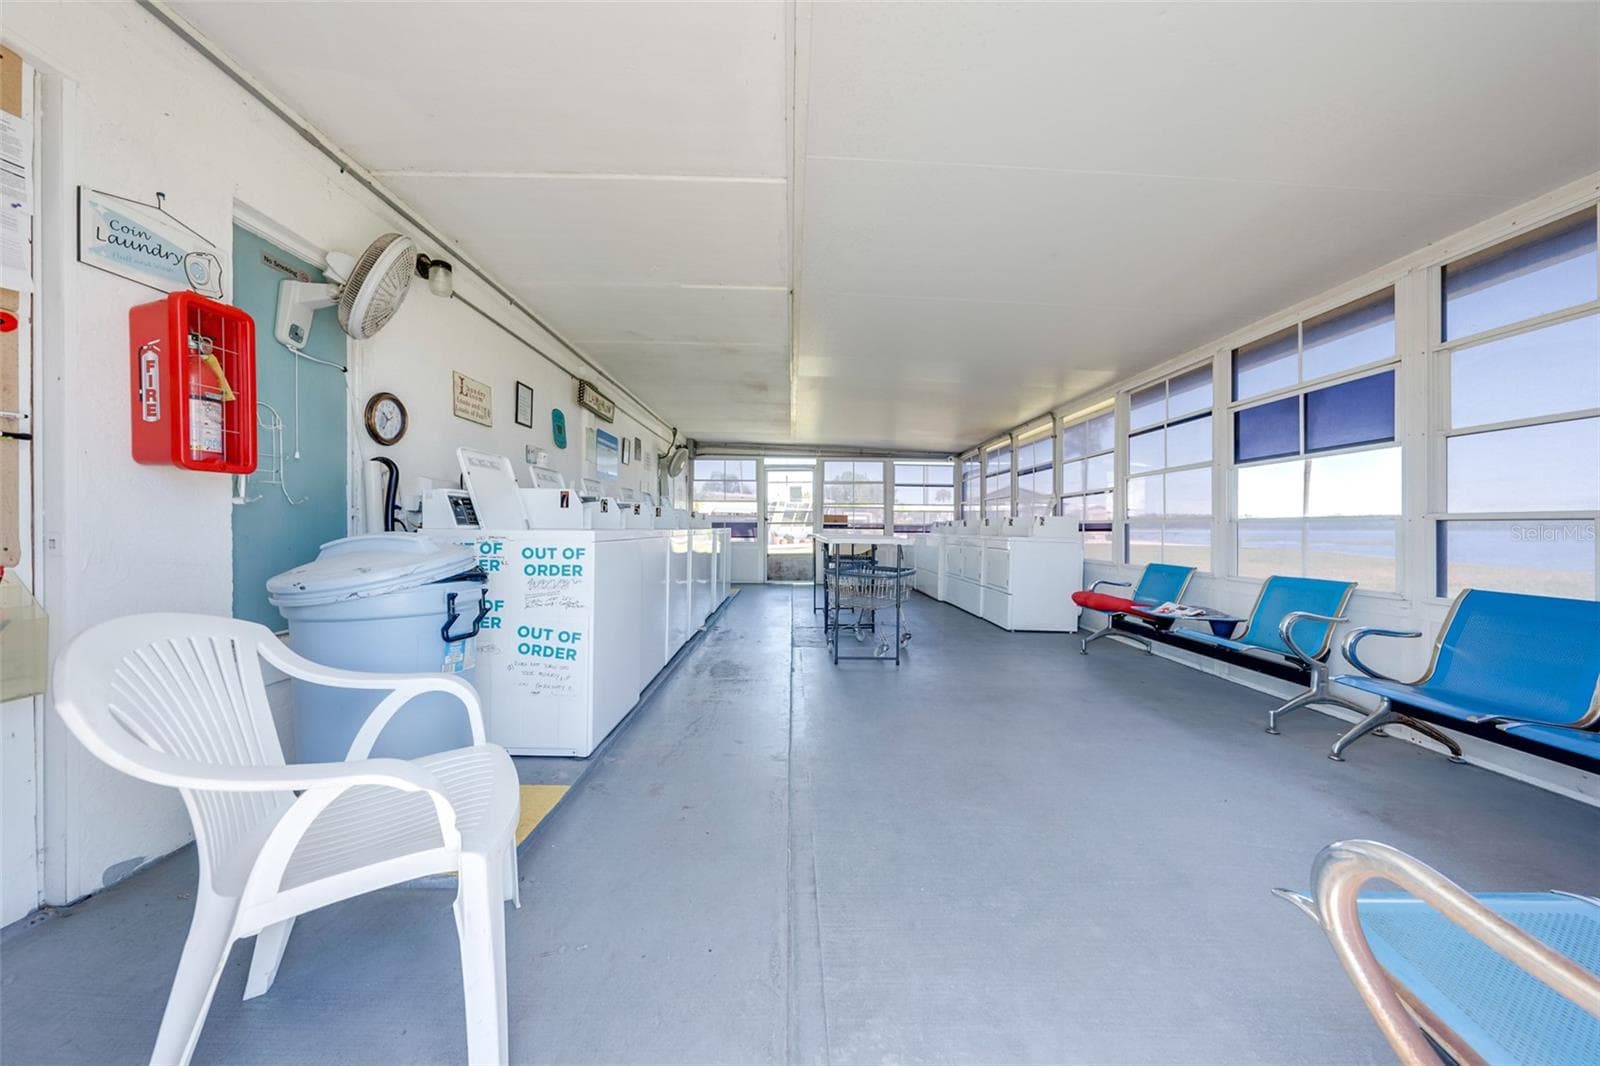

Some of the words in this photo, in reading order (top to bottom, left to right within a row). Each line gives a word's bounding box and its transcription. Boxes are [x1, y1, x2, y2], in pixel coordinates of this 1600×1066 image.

[109, 219, 151, 240] Coin
[96, 226, 183, 266] Laundry
[146, 360, 157, 417] FIRE
[560, 490, 569, 508] 7
[480, 542, 503, 555] OF
[521, 547, 557, 560] OUT
[562, 547, 586, 560] OF
[524, 564, 583, 577] ORDER
[517, 625, 554, 641] OUT
[558, 630, 582, 644] OF
[518, 642, 577, 661] ORDER
